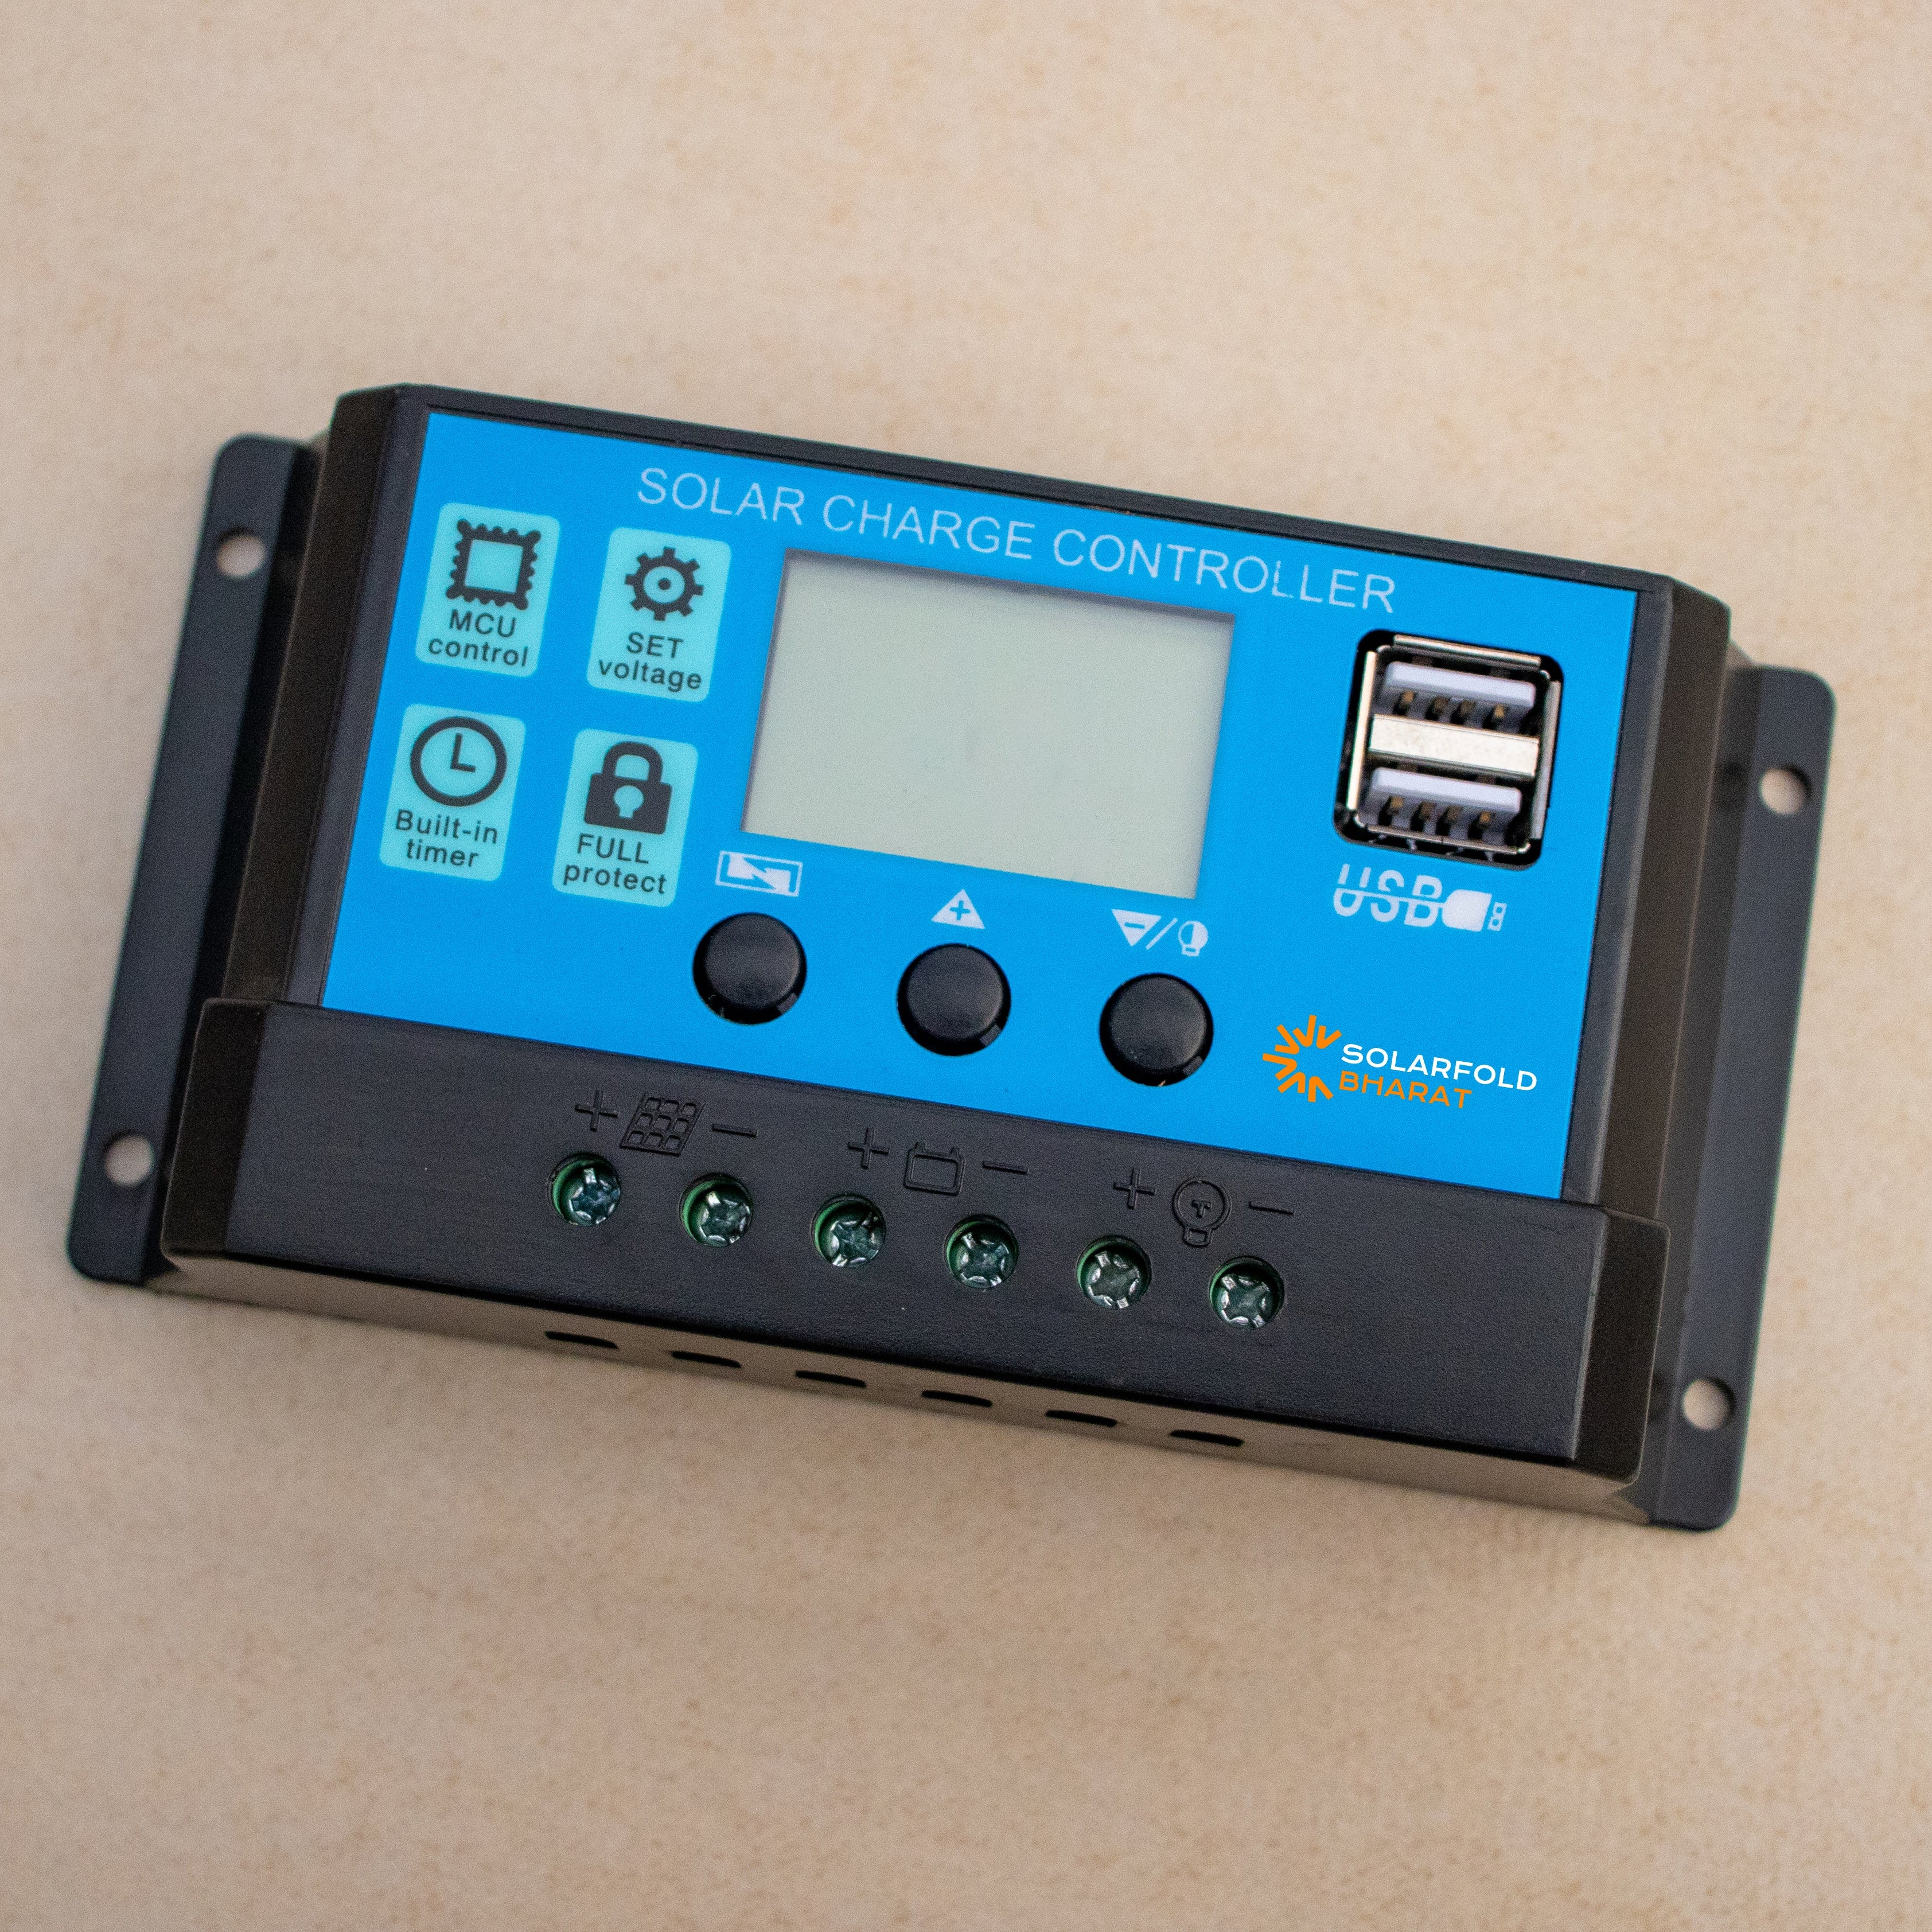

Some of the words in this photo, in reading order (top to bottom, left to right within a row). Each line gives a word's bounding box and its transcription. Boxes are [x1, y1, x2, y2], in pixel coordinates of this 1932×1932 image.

[637, 468, 805, 525] SOLAR
[823, 494, 1035, 560] CHARGE
[1053, 528, 1396, 614] CONTROLLER
[449, 609, 517, 638] MCU
[427, 636, 529, 668] control
[626, 632, 684, 659] SET
[598, 658, 703, 693] voltage
[395, 809, 498, 844] Built-in
[406, 840, 479, 868] timer
[577, 832, 650, 864] FULL
[563, 862, 667, 895] protect
[1333, 863, 1443, 928] USB
[1341, 1043, 1538, 1091] SOLARFOLD
[1338, 1070, 1473, 1109] BHARAT
